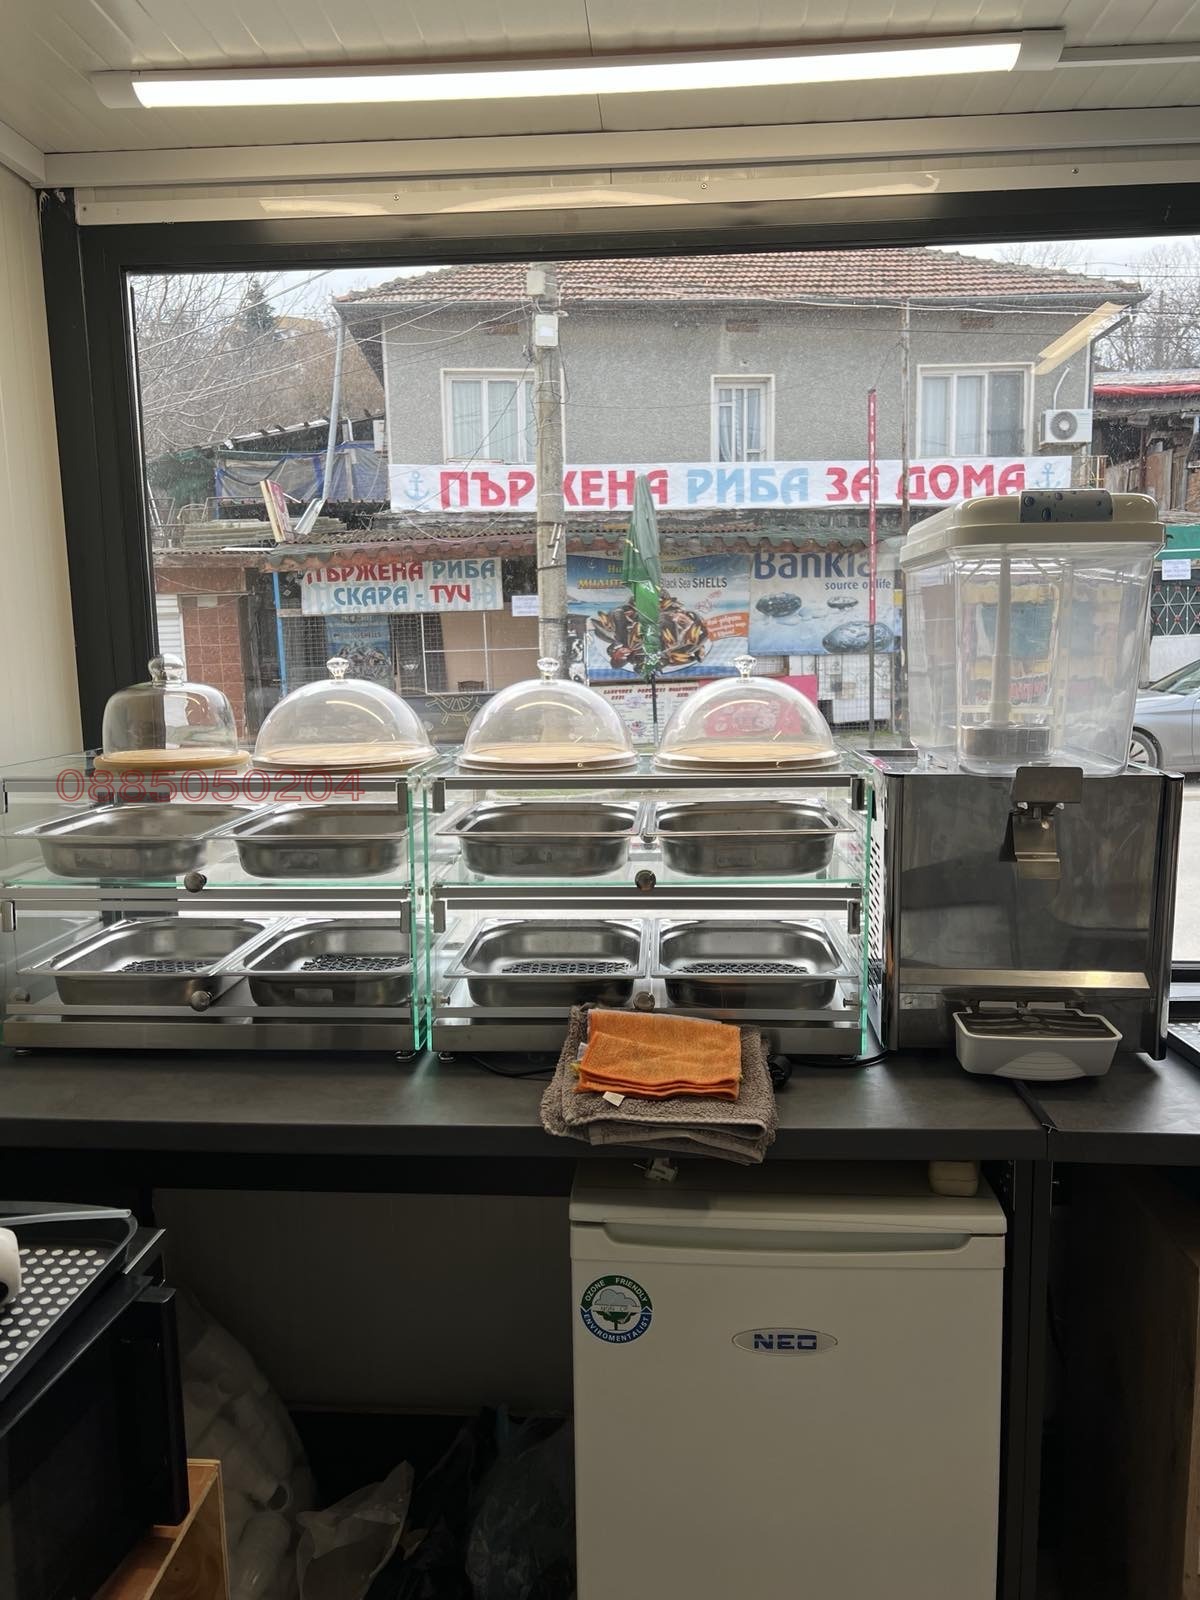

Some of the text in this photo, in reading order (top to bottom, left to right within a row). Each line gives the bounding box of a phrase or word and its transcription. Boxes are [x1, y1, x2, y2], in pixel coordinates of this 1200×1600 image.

[686, 467, 809, 504] РИБА
[825, 467, 879, 503] ЗА
[895, 464, 1026, 502] ДОМА
[432, 559, 495, 579] РИБА
[679, 577, 691, 588] Sea
[692, 577, 728, 588] SHELLS
[824, 581, 859, 590] source
[875, 578, 891, 590] life
[333, 585, 408, 606] СКАРА
[429, 584, 471, 603] ТУЧ
[585, 1277, 648, 1302] OZONE FRIENDLY
[583, 1313, 649, 1342] ENVIROMENTALIST
[754, 1333, 817, 1350] NEO
